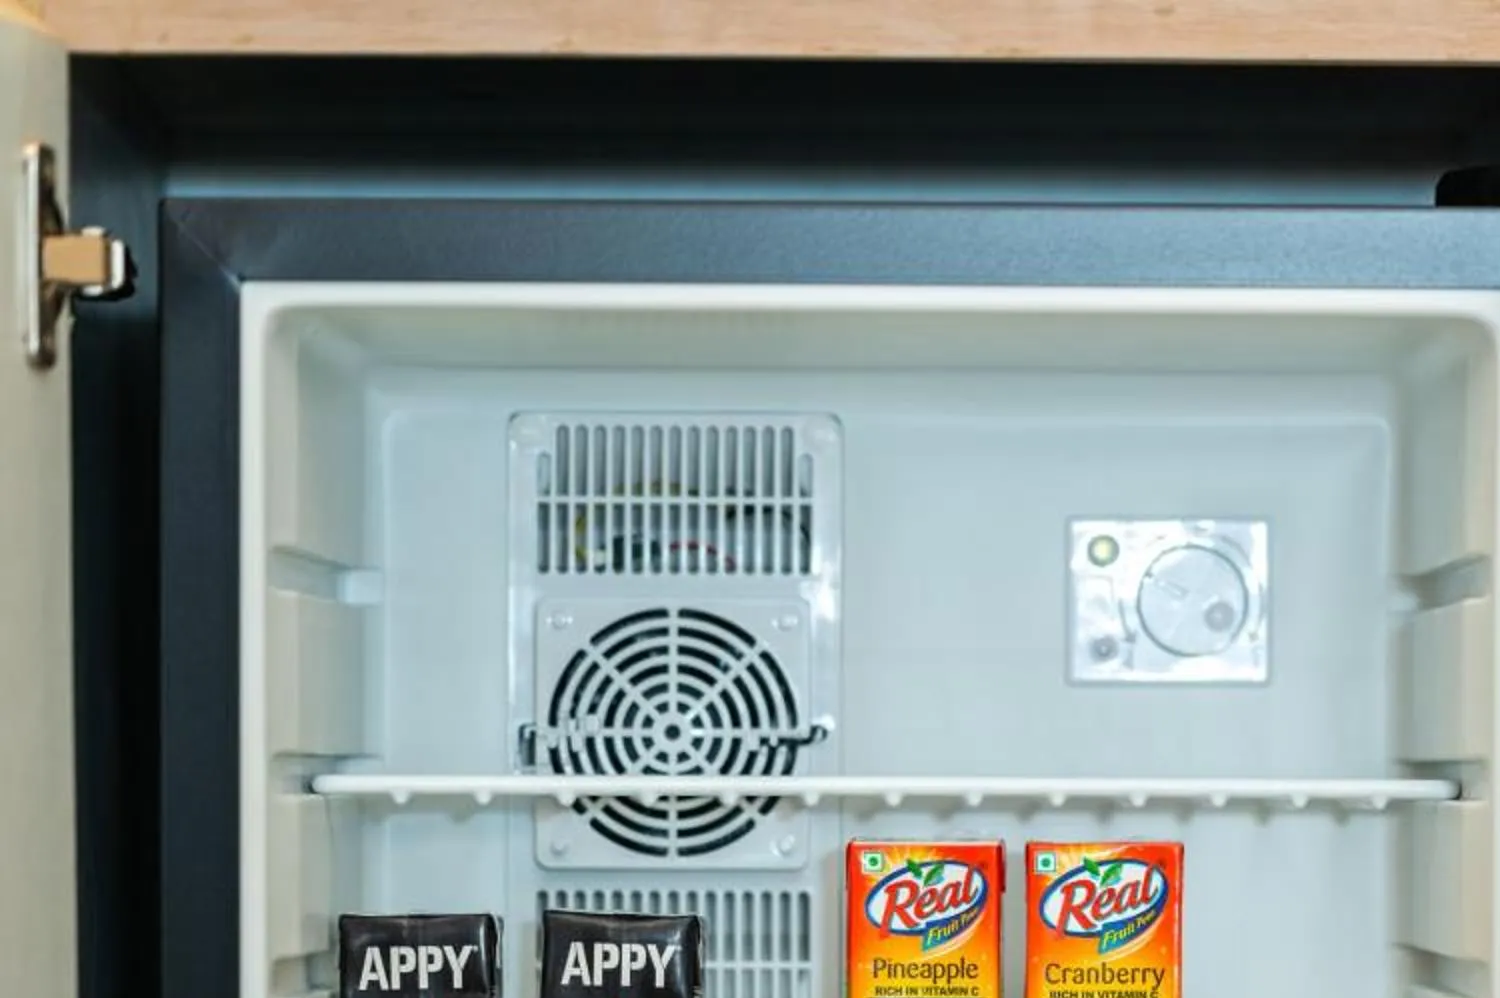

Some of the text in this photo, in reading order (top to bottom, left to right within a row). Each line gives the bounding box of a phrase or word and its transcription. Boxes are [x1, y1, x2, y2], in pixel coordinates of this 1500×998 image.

[880, 863, 978, 938] Real
[1055, 863, 1159, 938] Real
[927, 921, 959, 945] Fruit
[1103, 923, 1135, 947] Fruit
[358, 945, 475, 991] APPY
[560, 941, 677, 988] APPY
[873, 955, 979, 984] Pineapple
[1045, 962, 1165, 991] Cranberry
[875, 986, 980, 996] RICH IN VITAMIN C
